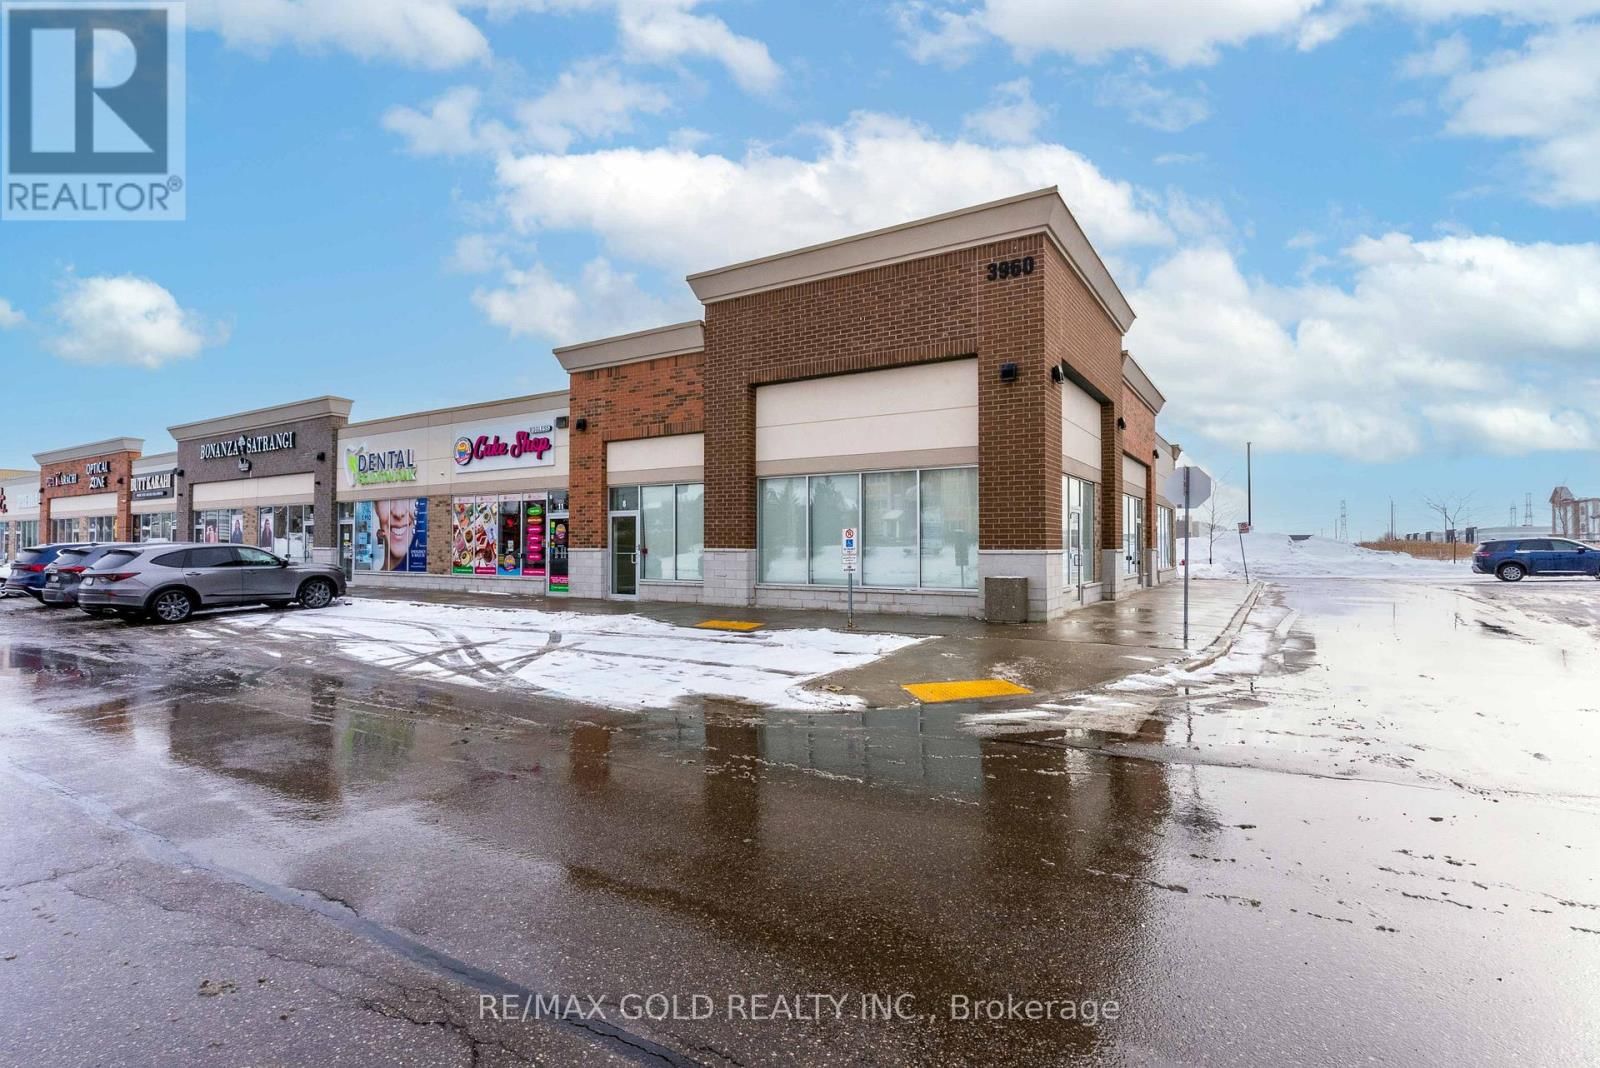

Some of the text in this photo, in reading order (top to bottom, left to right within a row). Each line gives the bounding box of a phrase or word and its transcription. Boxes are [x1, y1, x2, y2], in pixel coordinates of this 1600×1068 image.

[987, 256, 1034, 281] 3960
[200, 431, 294, 460] BONANZA SATRANGI
[474, 431, 552, 460] Cake Shop
[358, 449, 414, 472] DENTAL
[89, 476, 107, 488] ZONE
